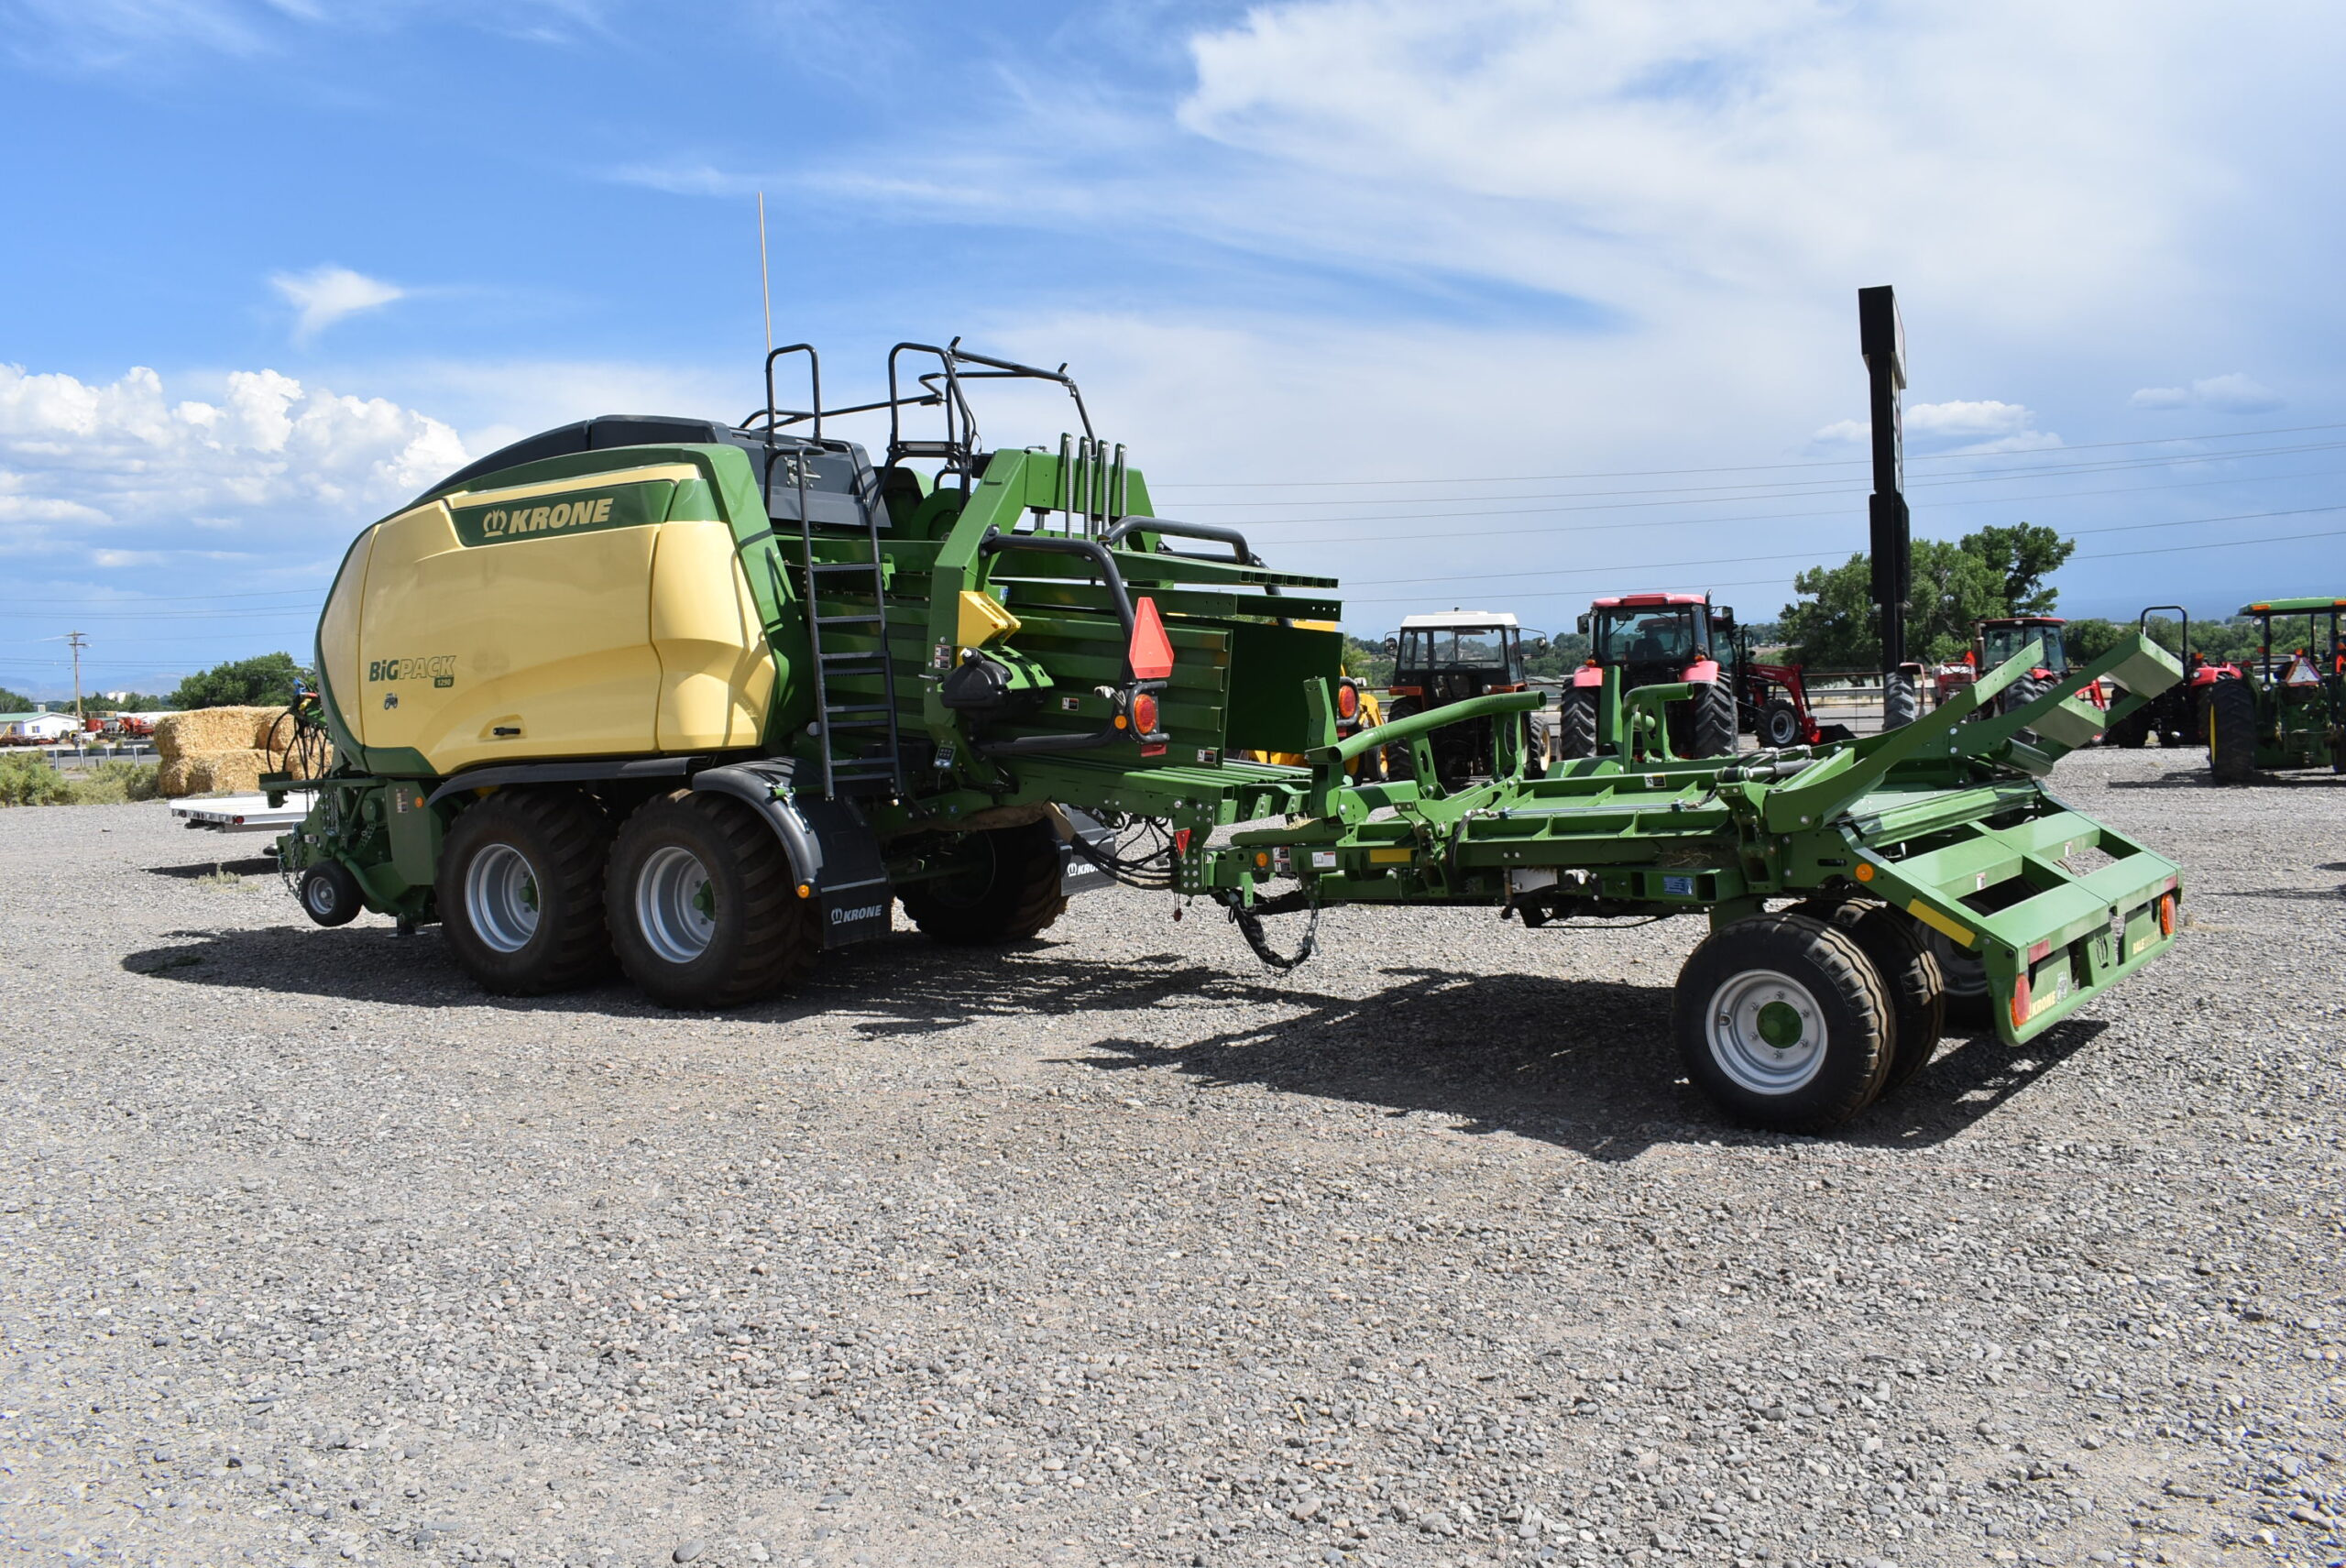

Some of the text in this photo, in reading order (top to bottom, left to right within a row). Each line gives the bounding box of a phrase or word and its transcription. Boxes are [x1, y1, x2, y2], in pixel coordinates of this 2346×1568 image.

[508, 498, 614, 534] KRONE
[843, 905, 882, 923] KRONE
[2032, 990, 2056, 1017] KRONE
